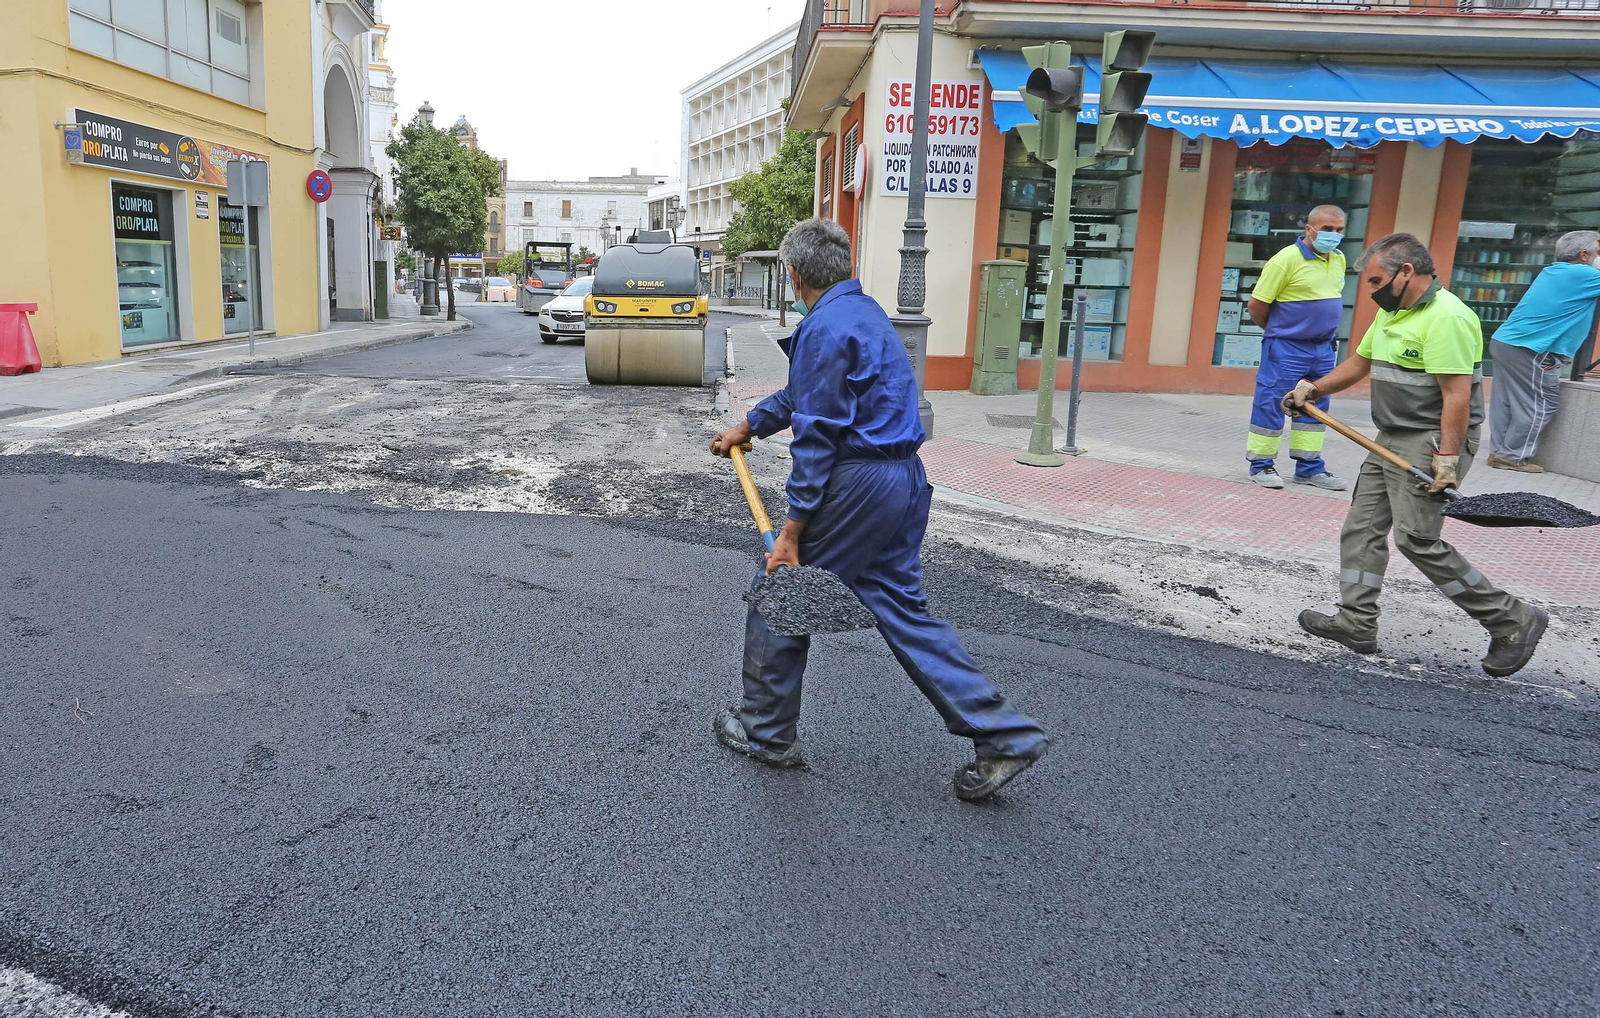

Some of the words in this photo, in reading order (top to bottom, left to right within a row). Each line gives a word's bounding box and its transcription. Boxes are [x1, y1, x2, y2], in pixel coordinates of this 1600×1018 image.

[889, 82, 912, 107] SE
[931, 84, 980, 108] ENDE
[885, 113, 979, 136] 61059173
[1167, 110, 1220, 128] Coser
[85, 120, 122, 142] COMPRO
[83, 140, 129, 162] ORO/PLATA
[135, 137, 150, 149] Euros
[150, 141, 159, 151] por
[884, 142, 931, 156] LIQUIDAN
[933, 144, 977, 158] PATCHWORK
[132, 149, 139, 158] No
[886, 159, 906, 172] POR
[909, 160, 961, 174] SLADO
[963, 161, 973, 175] A:
[963, 178, 972, 194] 9
[119, 196, 154, 214] COMPRO
[116, 215, 159, 233] ORO/PLATA
[637, 280, 665, 288] BOMAG
